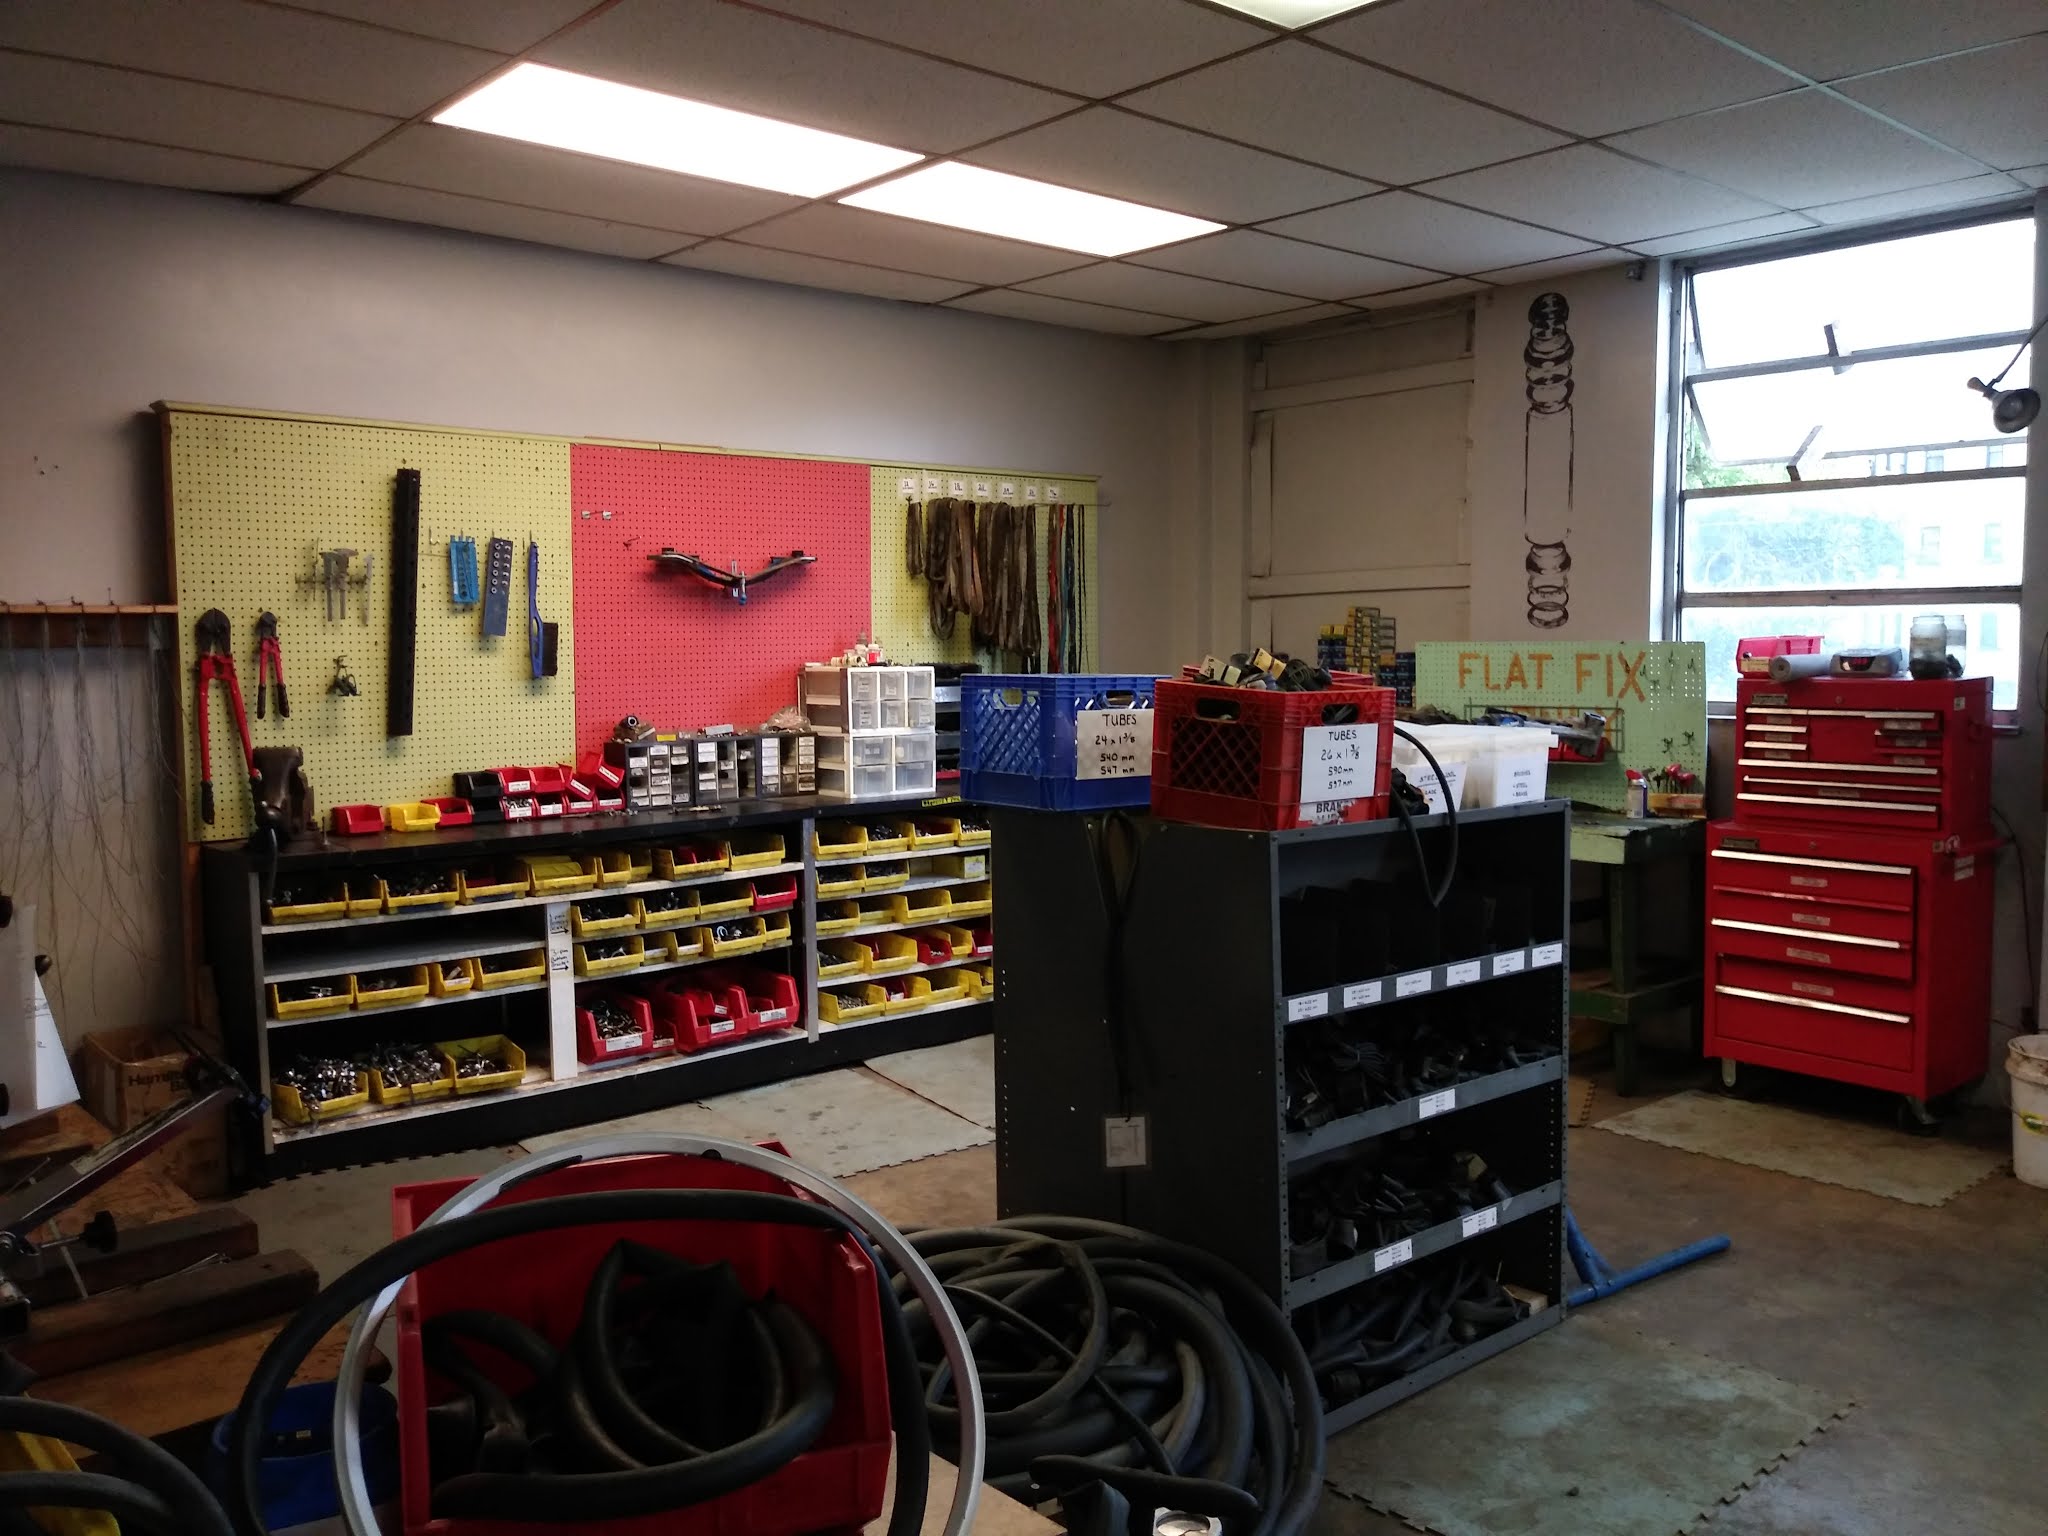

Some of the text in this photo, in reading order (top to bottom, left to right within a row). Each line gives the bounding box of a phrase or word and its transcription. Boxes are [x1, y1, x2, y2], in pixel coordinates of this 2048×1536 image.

[1458, 650, 1647, 702] FLAT FIX
[1101, 713, 1137, 727] TUBES
[1095, 735, 1107, 745] 24
[1328, 729, 1357, 741] TUBES
[1100, 753, 1118, 762] 540
[1320, 749, 1333, 761] 26
[1100, 765, 1118, 775] 547
